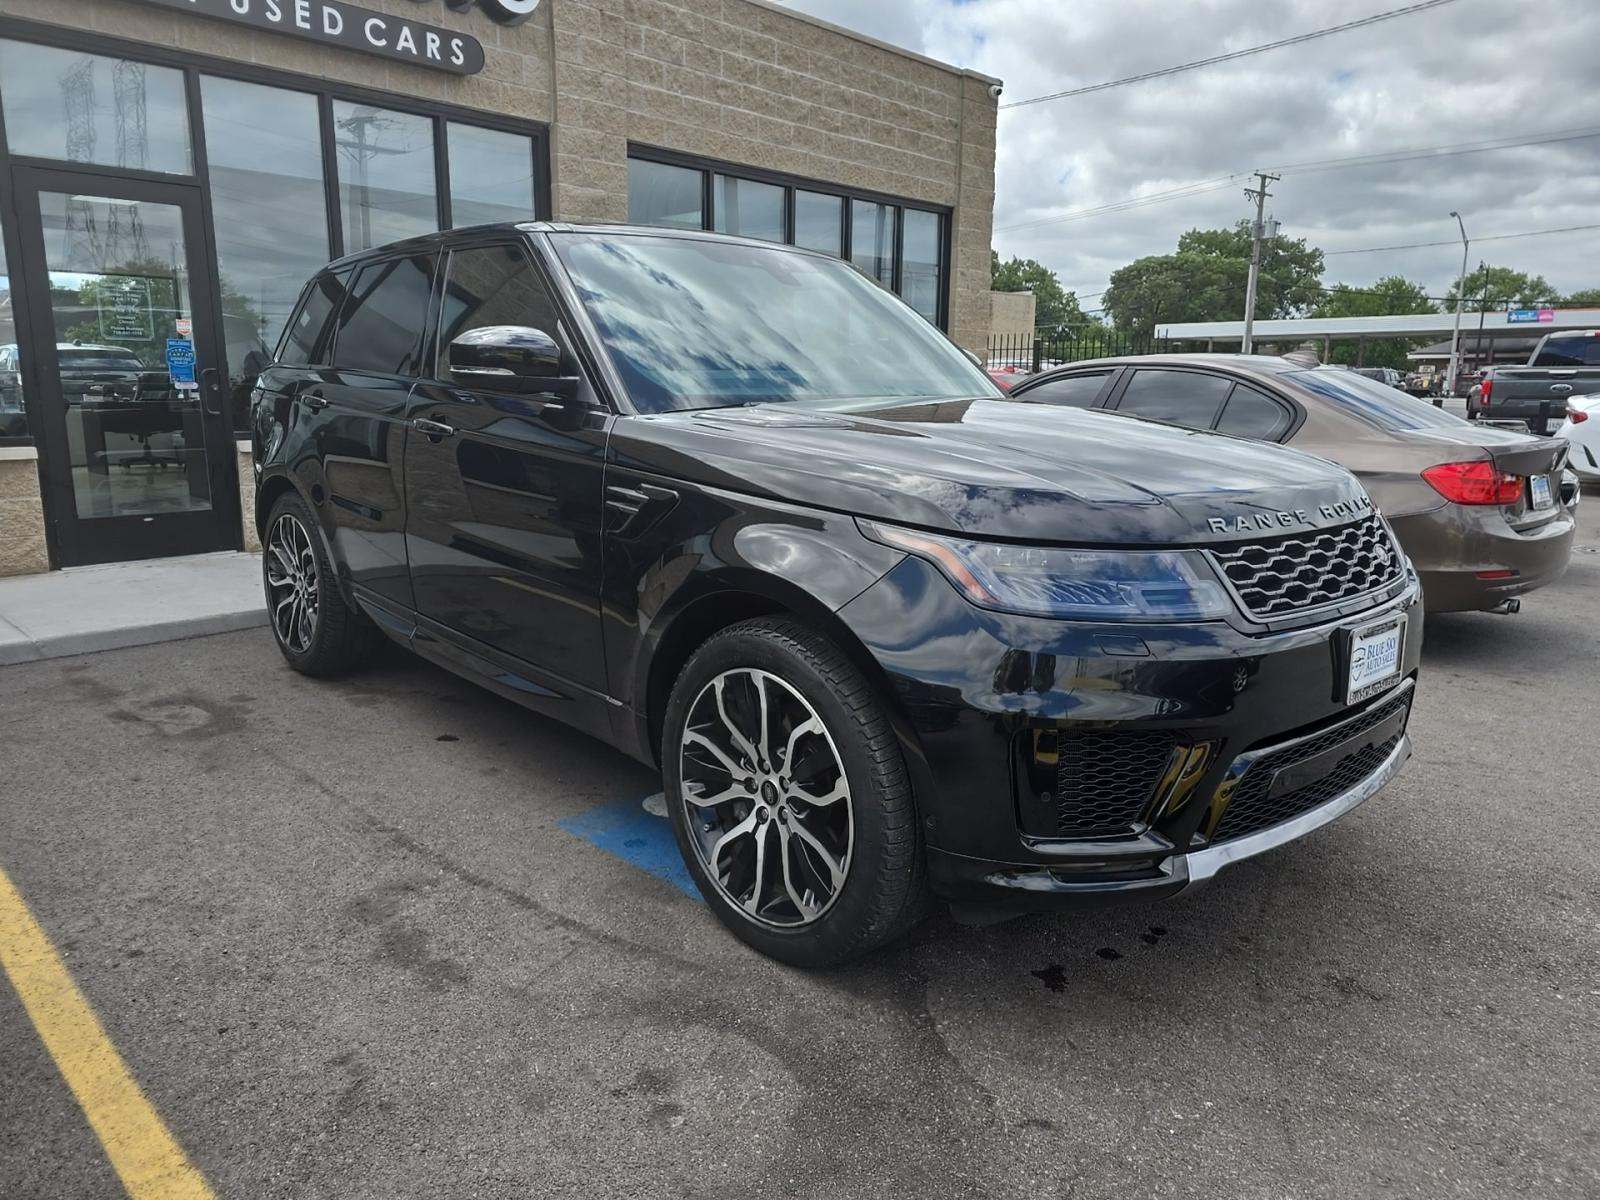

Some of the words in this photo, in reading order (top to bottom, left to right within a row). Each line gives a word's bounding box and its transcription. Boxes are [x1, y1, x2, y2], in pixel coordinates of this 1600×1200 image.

[231, 0, 343, 36] USED
[364, 18, 464, 65] CARS
[1207, 509, 1309, 534] RANGE
